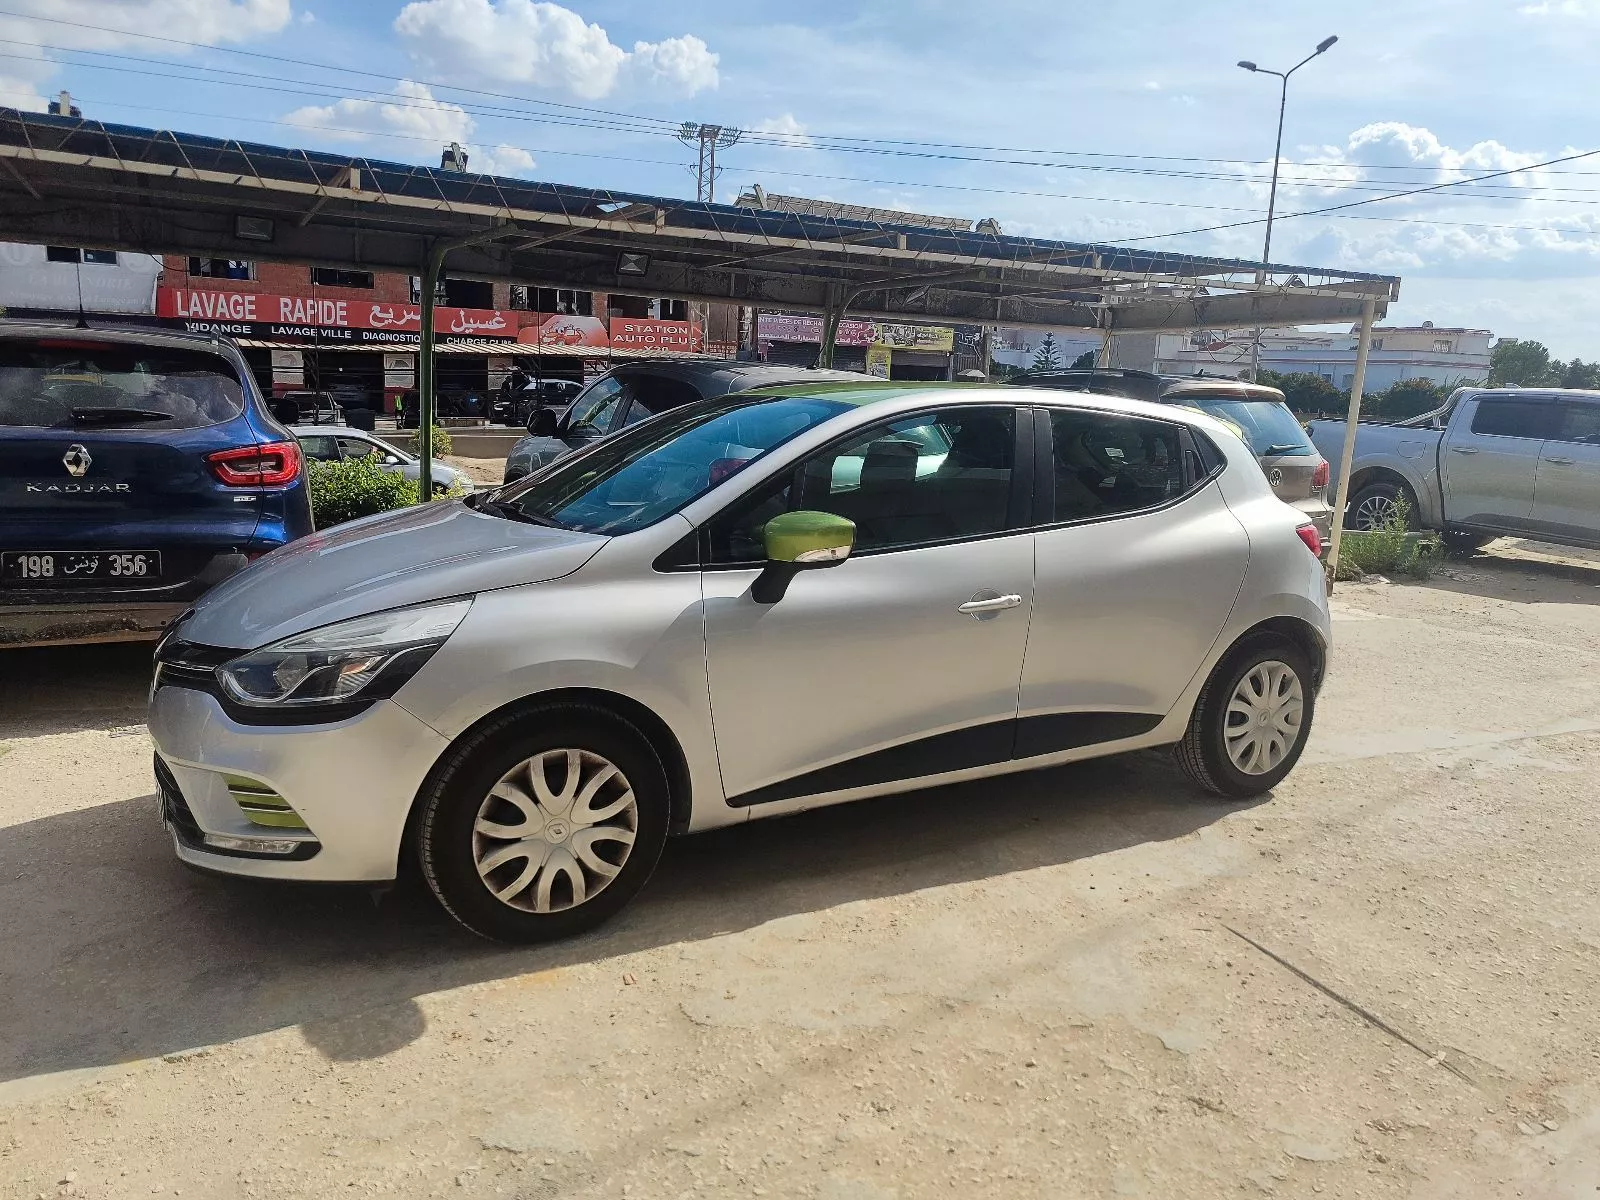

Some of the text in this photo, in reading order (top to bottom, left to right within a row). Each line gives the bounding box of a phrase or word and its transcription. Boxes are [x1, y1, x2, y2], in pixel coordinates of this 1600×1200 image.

[177, 291, 257, 320] LAVAGE
[279, 297, 349, 326] RAPIDE
[184, 321, 252, 334] VIDANGE
[271, 325, 318, 337] LAVAGE
[320, 328, 352, 339] VILLE
[362, 331, 421, 343] DIAGNOSTIQ
[446, 336, 487, 345] CHARGE
[451, 309, 507, 333] غسيل
[624, 324, 688, 336] STATION
[613, 334, 656, 346] AUTO
[660, 336, 697, 348] PLUS
[26, 483, 132, 493] KADJAR
[18, 554, 147, 578] 198 تونس 356
